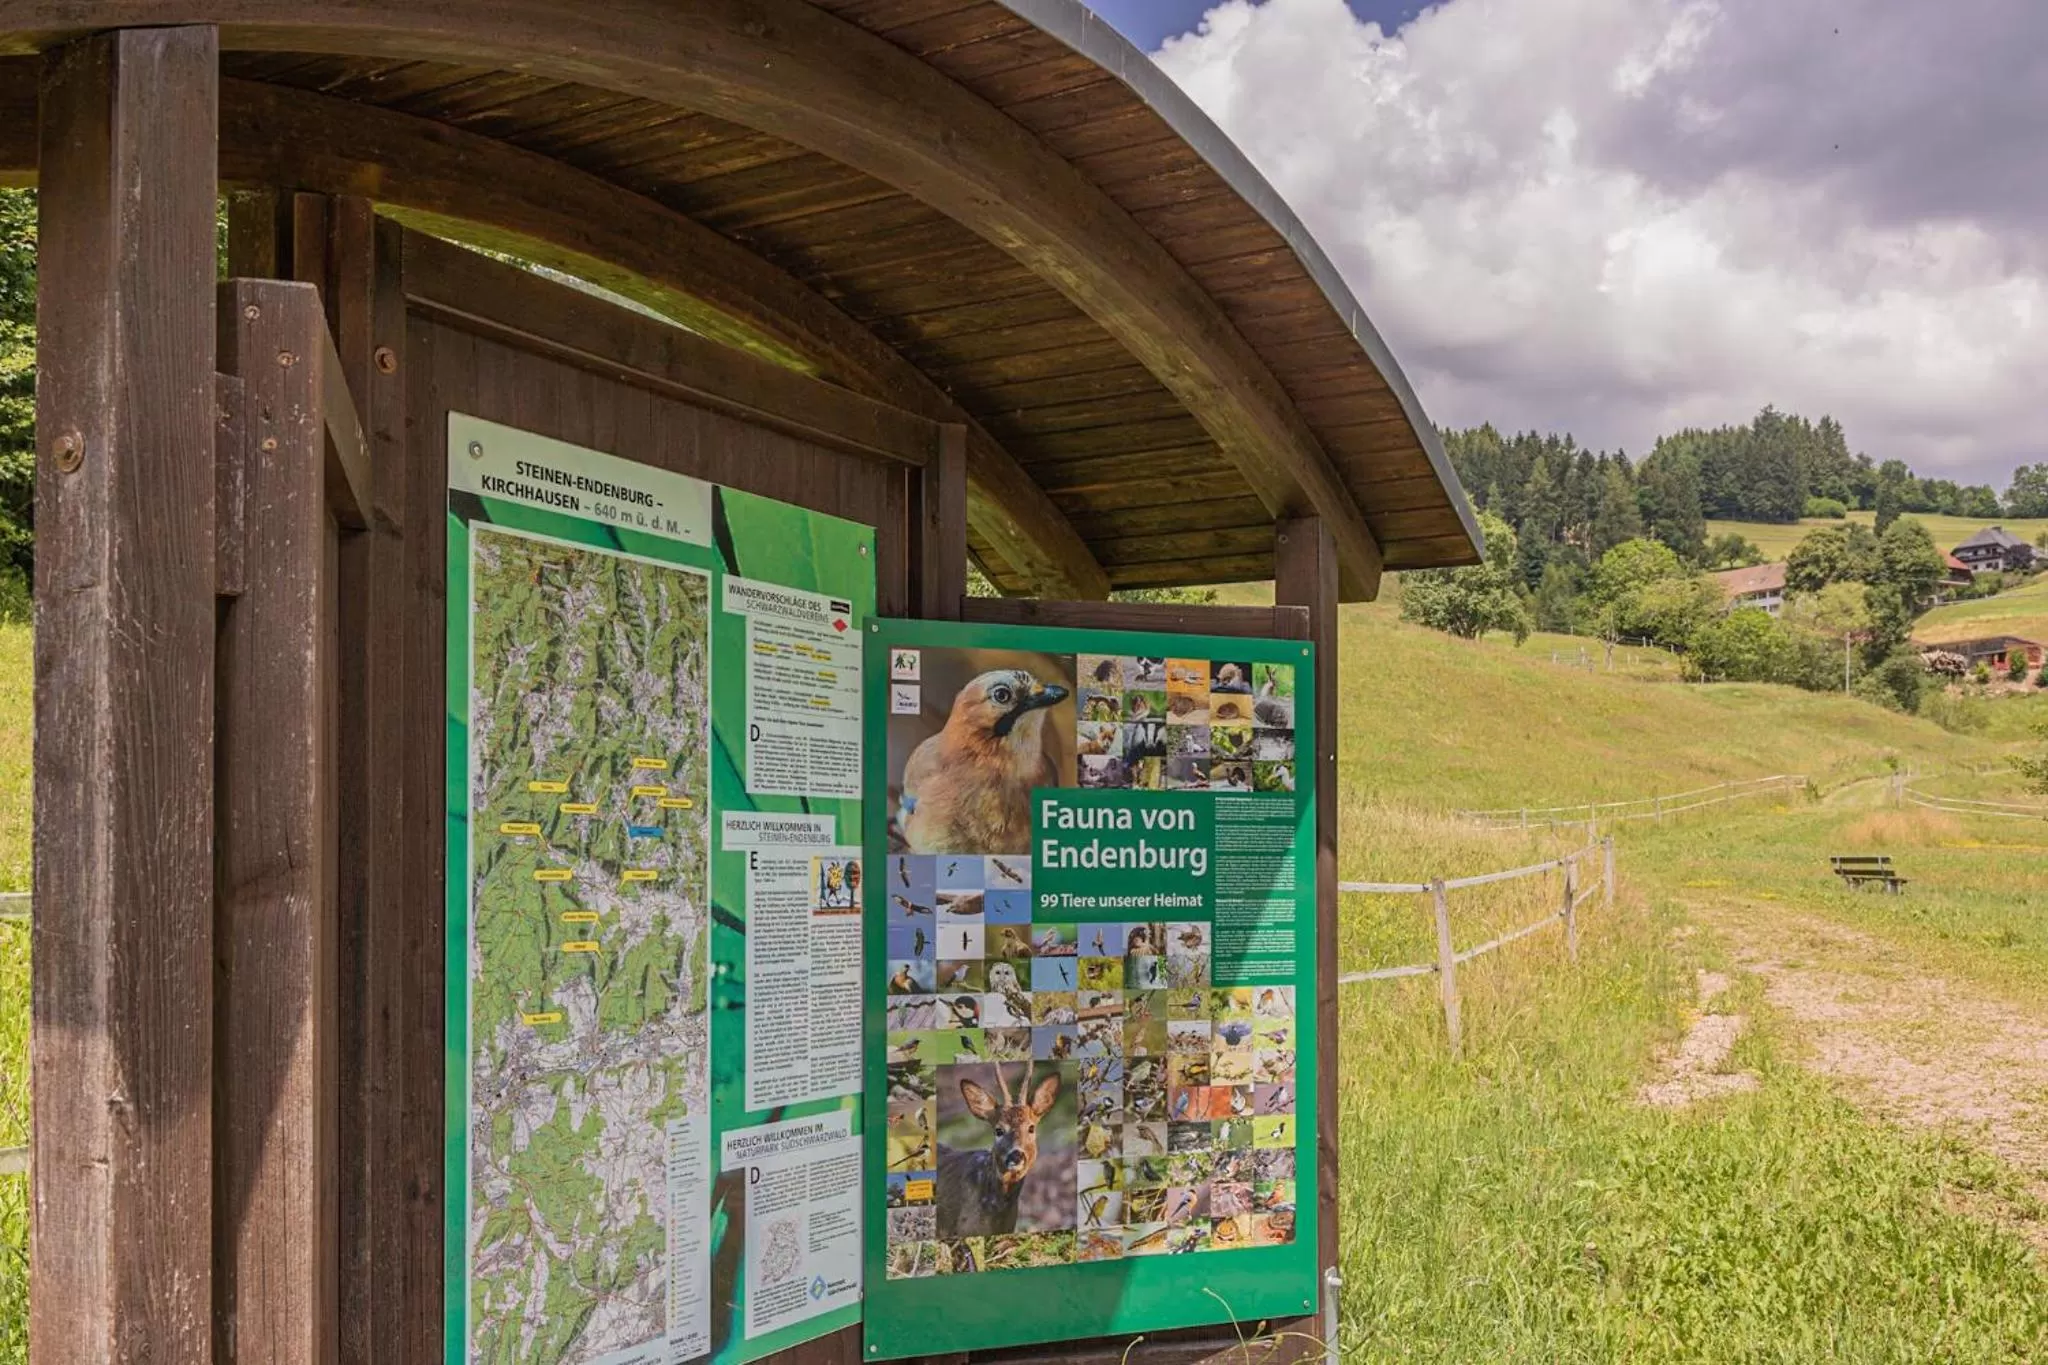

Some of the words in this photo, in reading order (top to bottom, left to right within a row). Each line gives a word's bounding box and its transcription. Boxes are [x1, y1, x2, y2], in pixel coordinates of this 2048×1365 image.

[516, 460, 653, 508] STEINEN-ENDENBURG
[481, 474, 580, 511] KIRCHHAUSEN
[594, 502, 617, 520] 640
[620, 510, 632, 523] m
[636, 509, 648, 527] ü.
[650, 514, 664, 530] d.
[666, 518, 681, 535] M.
[728, 584, 807, 609] WANDERVORSCHLÄGE
[808, 601, 822, 612] DES
[746, 599, 829, 623] SCHWARZWALDVEREINS
[726, 820, 761, 831] HERZLICH
[762, 821, 812, 832] WILLKOMMEN
[813, 823, 822, 832] IN
[1041, 800, 1132, 830] Fauna
[1141, 807, 1195, 831] von
[758, 833, 831, 843] STEINEN-ENDENBURG
[1041, 839, 1208, 876] Endenburg
[1040, 893, 1059, 907] 99
[1060, 893, 1096, 908] Tiere
[1098, 895, 1151, 908] unserer
[1153, 893, 1203, 908] Heimat
[727, 1135, 763, 1151] HERZLICH
[764, 1125, 813, 1144] WILLKOMMEN
[815, 1122, 824, 1134] IM
[736, 1143, 779, 1160] NATURPARK
